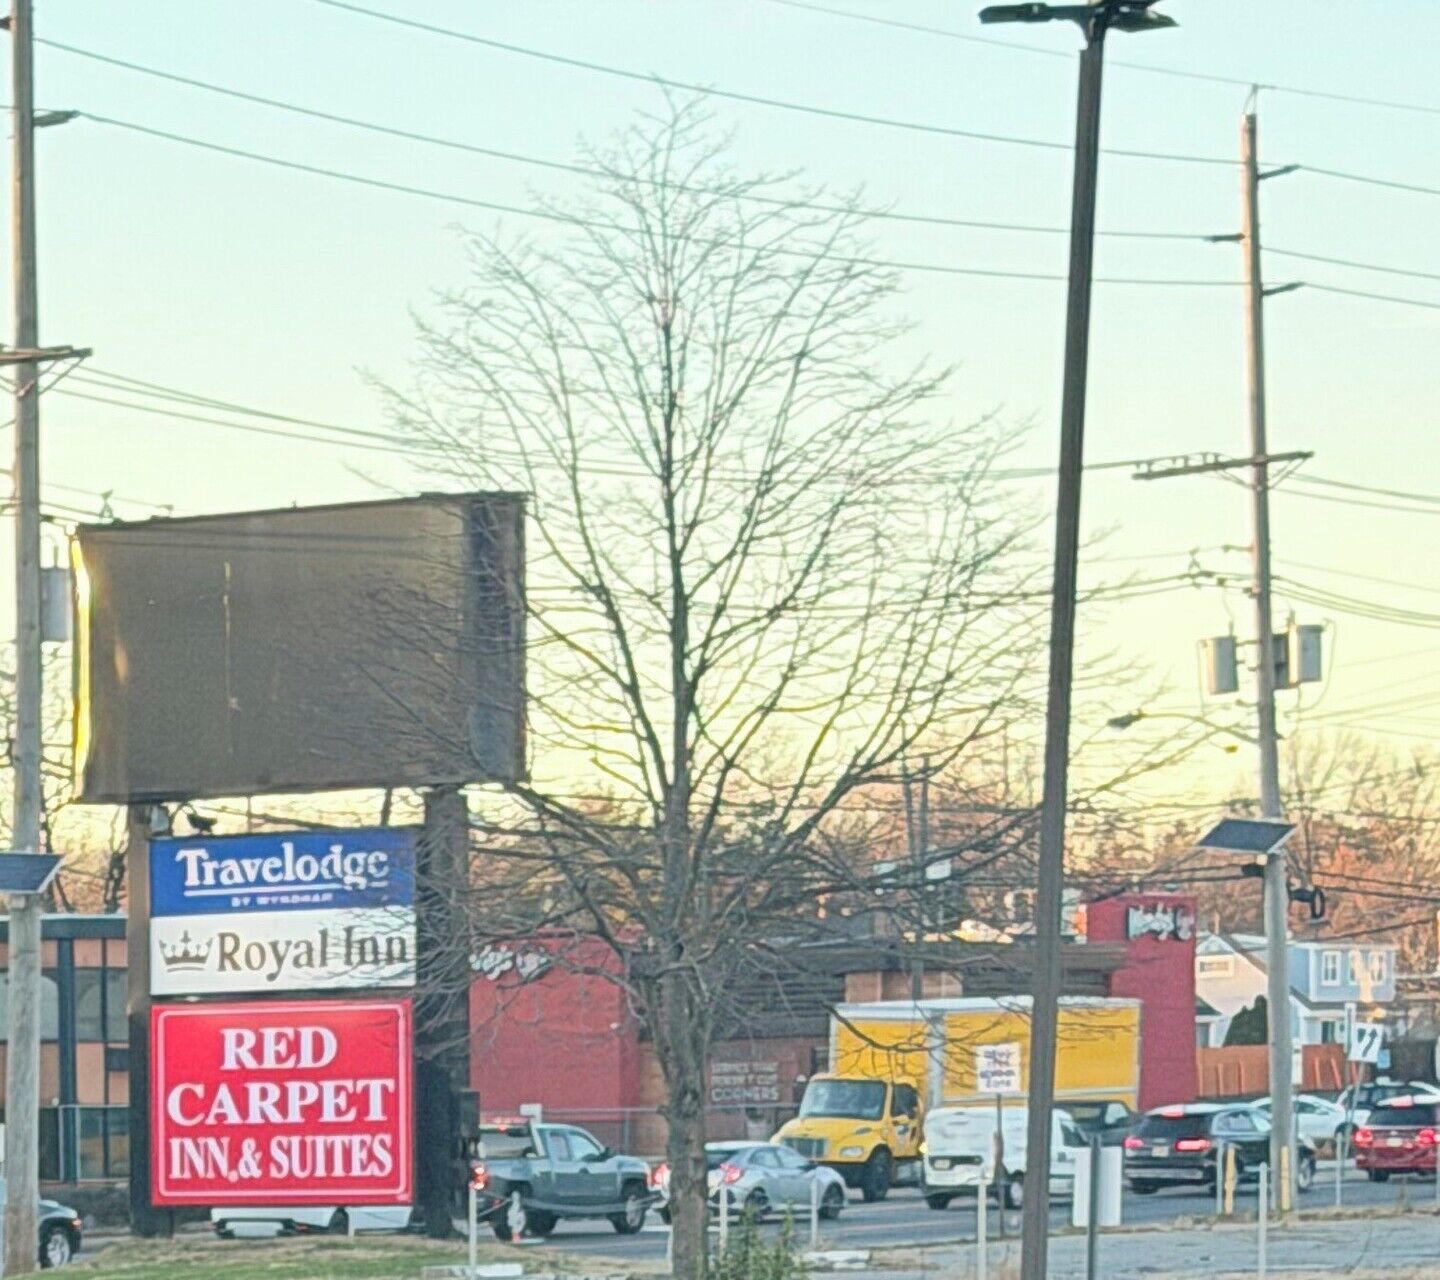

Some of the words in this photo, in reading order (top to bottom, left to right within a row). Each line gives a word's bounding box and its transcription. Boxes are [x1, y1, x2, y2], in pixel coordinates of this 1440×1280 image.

[175, 842, 389, 890] Travelodge
[217, 928, 328, 982] Royal
[344, 926, 407, 965] Inn
[220, 1027, 338, 1070] RED
[167, 1079, 395, 1126] CARPET
[269, 1133, 393, 1179] SUITES
